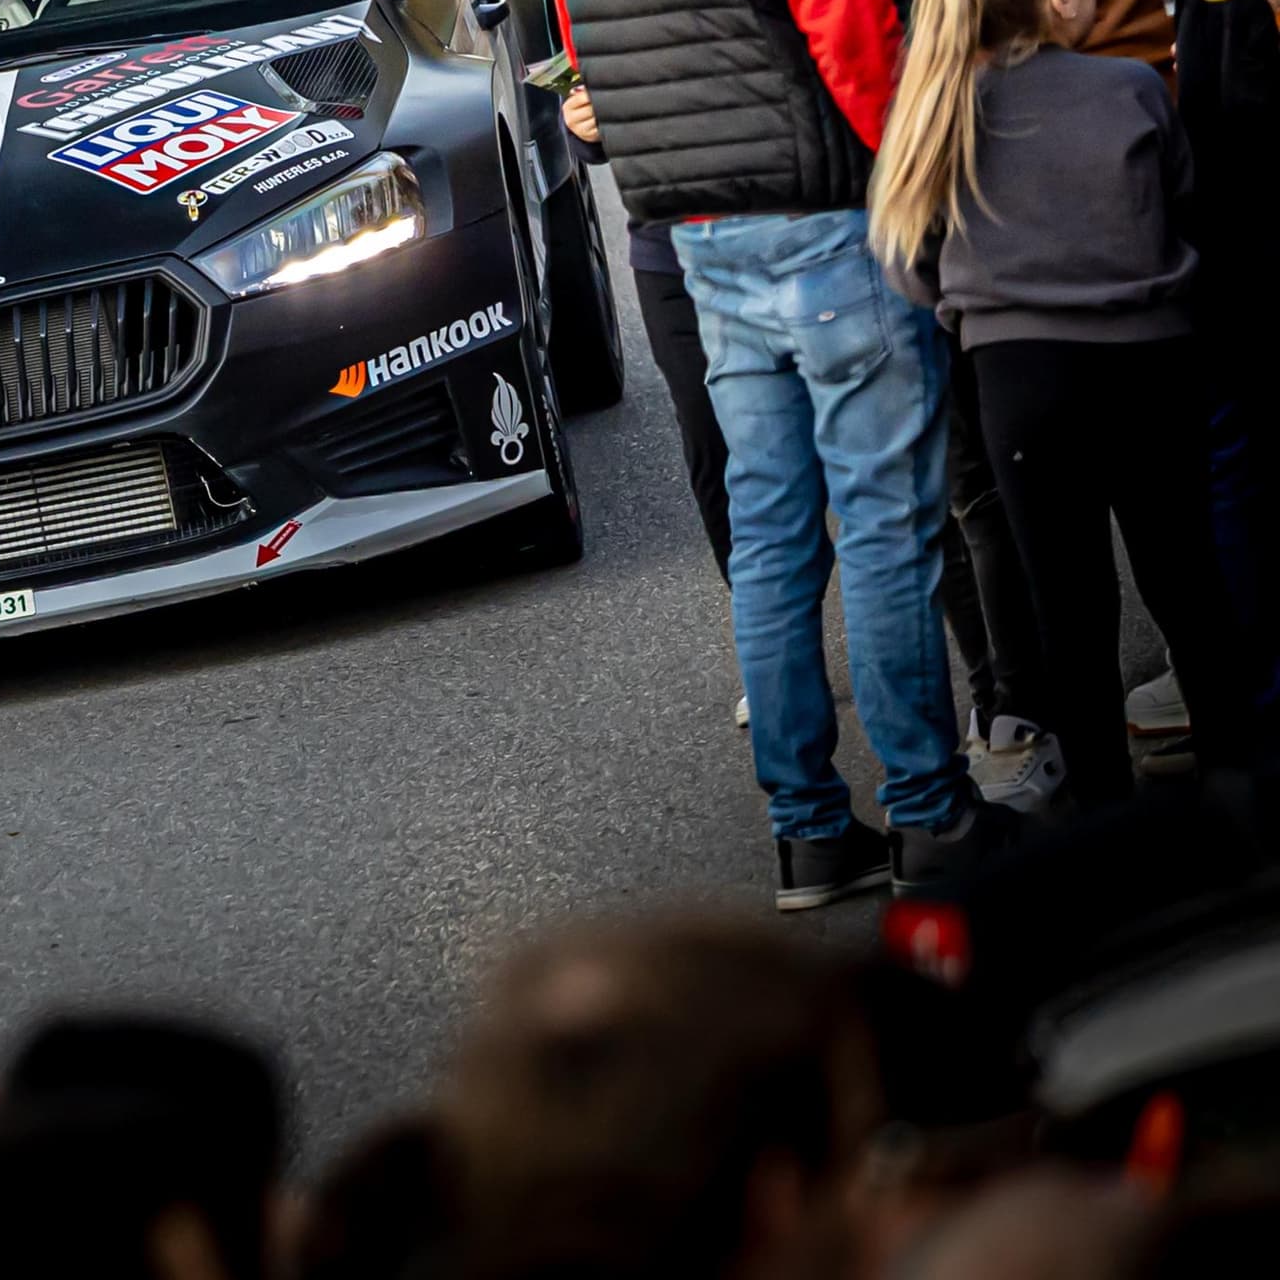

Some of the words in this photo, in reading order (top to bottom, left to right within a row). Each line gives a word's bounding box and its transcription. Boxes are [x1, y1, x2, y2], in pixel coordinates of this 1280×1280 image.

[55, 69, 162, 113] ADVANCING
[168, 40, 247, 69] MOTION
[63, 93, 239, 166] LIQUI
[109, 105, 282, 187] MOLY
[253, 157, 323, 194] HUNTERLES
